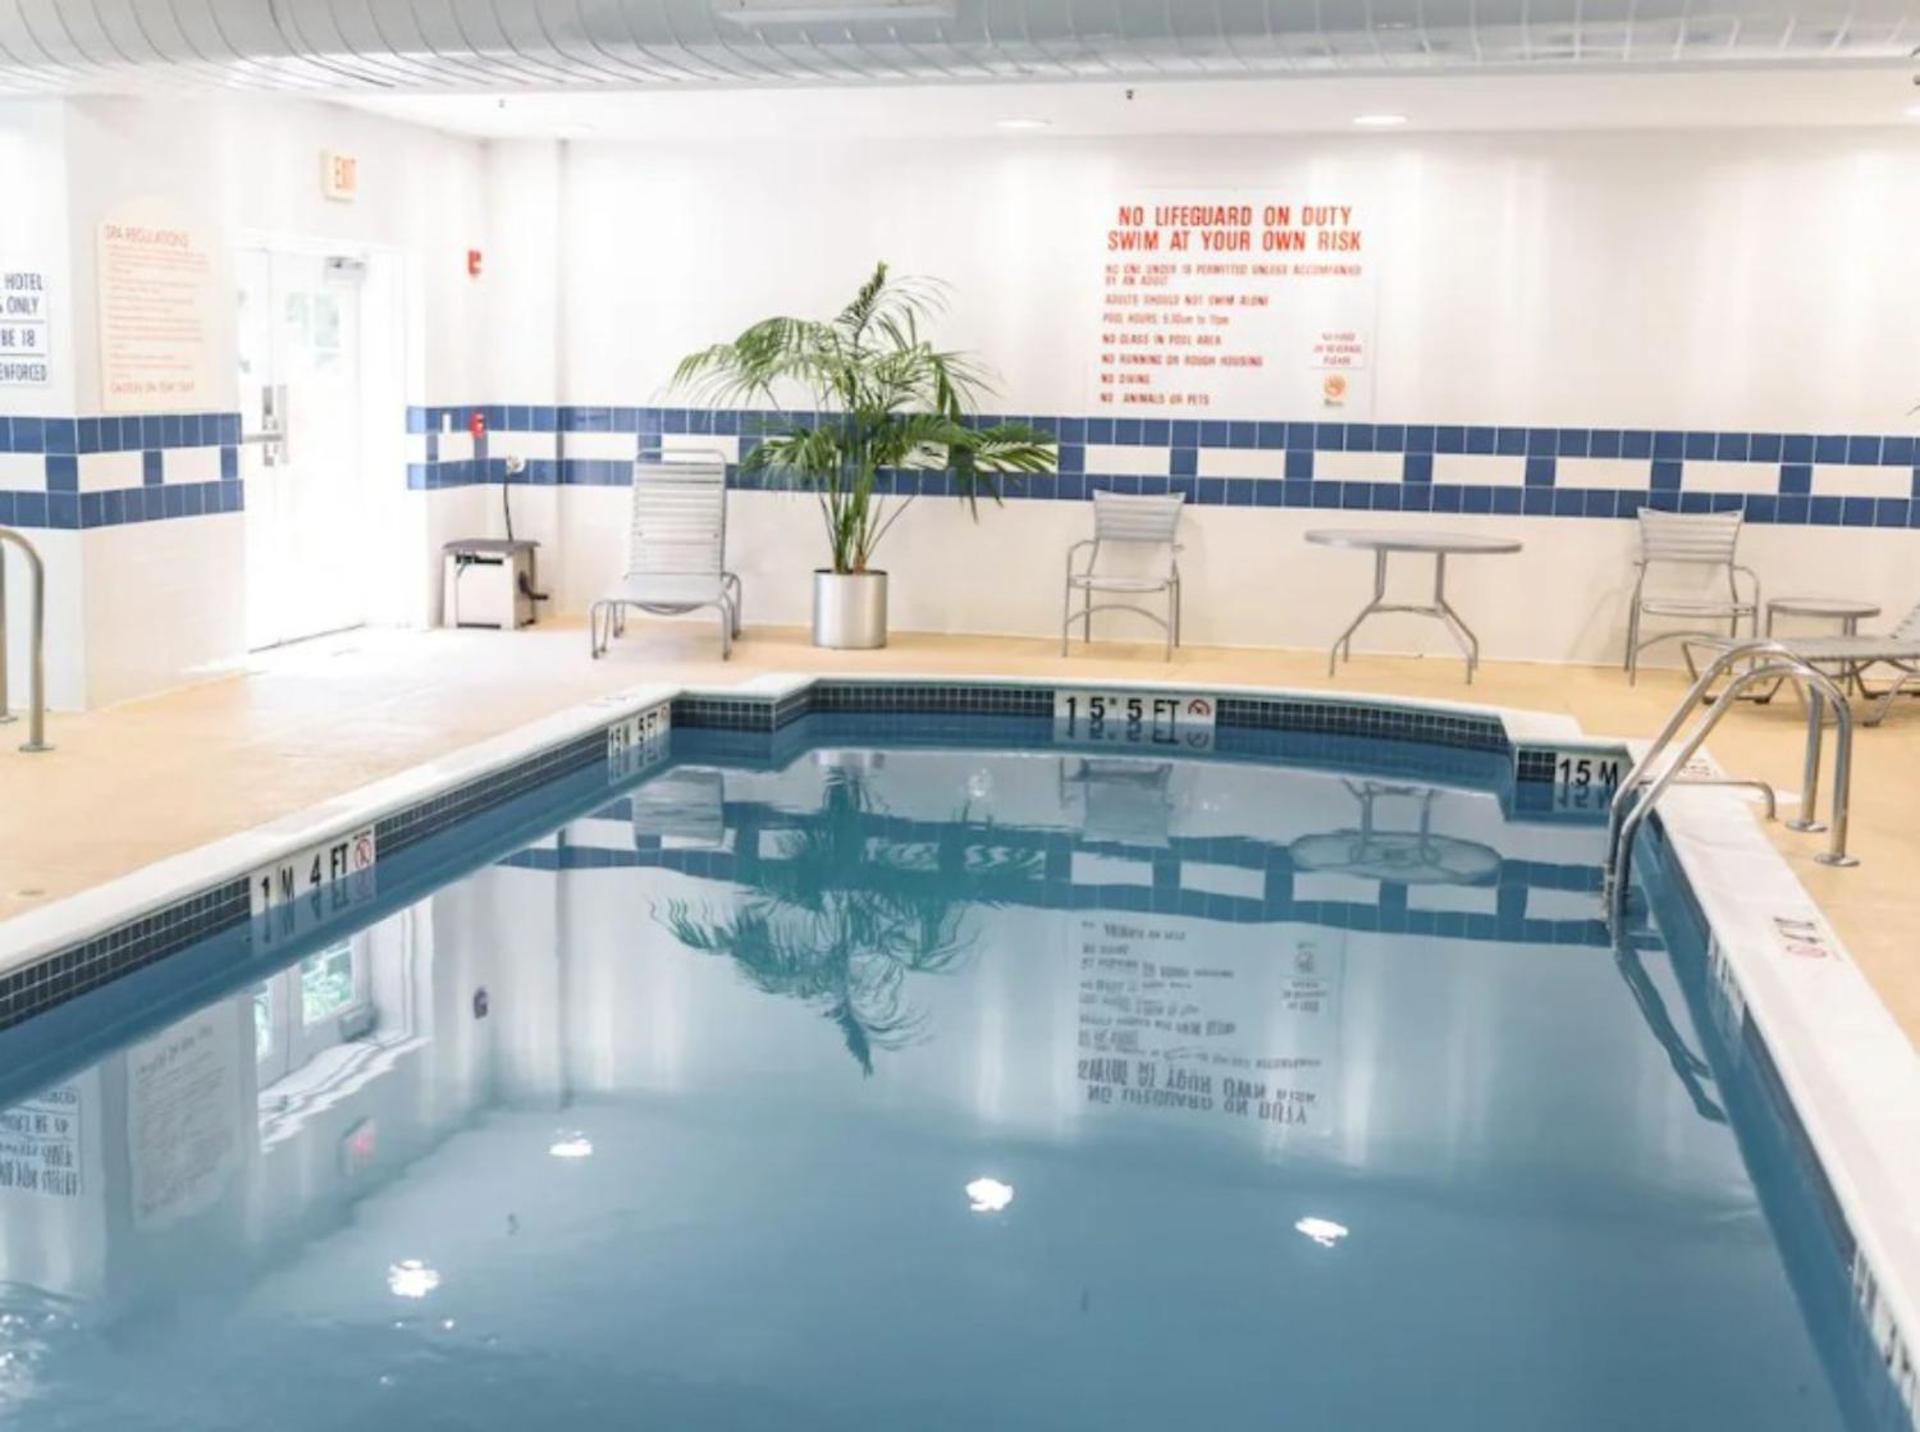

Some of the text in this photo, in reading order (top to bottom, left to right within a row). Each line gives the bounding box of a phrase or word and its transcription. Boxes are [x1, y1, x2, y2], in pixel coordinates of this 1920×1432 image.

[1119, 206, 1353, 226] NO LIFEGUARD ON DUTY
[1107, 231, 1361, 251] SWIM AT YOUR OWN RISK
[5, 273, 43, 291] HOTEL
[1123, 275, 1136, 286] AN
[6, 296, 39, 316] ONLY
[1144, 295, 1179, 305] SHOULD
[1185, 295, 1203, 306] NOT
[1209, 295, 1235, 306] SWIM
[1240, 296, 1269, 306] ALONE
[1, 329, 36, 347] BE 18
[1102, 334, 1222, 346] NO GLASS IN POOL AREA
[1101, 354, 1263, 367] NO RUNNING OR ROUGH HOUSING
[1101, 374, 1150, 385] NO DIVING
[1100, 393, 1210, 406] NO ANIMALS OR PETS
[1153, 699, 1180, 726] FT
[1599, 760, 1619, 787] M
[310, 852, 321, 888] 4
[330, 842, 349, 880] FT
